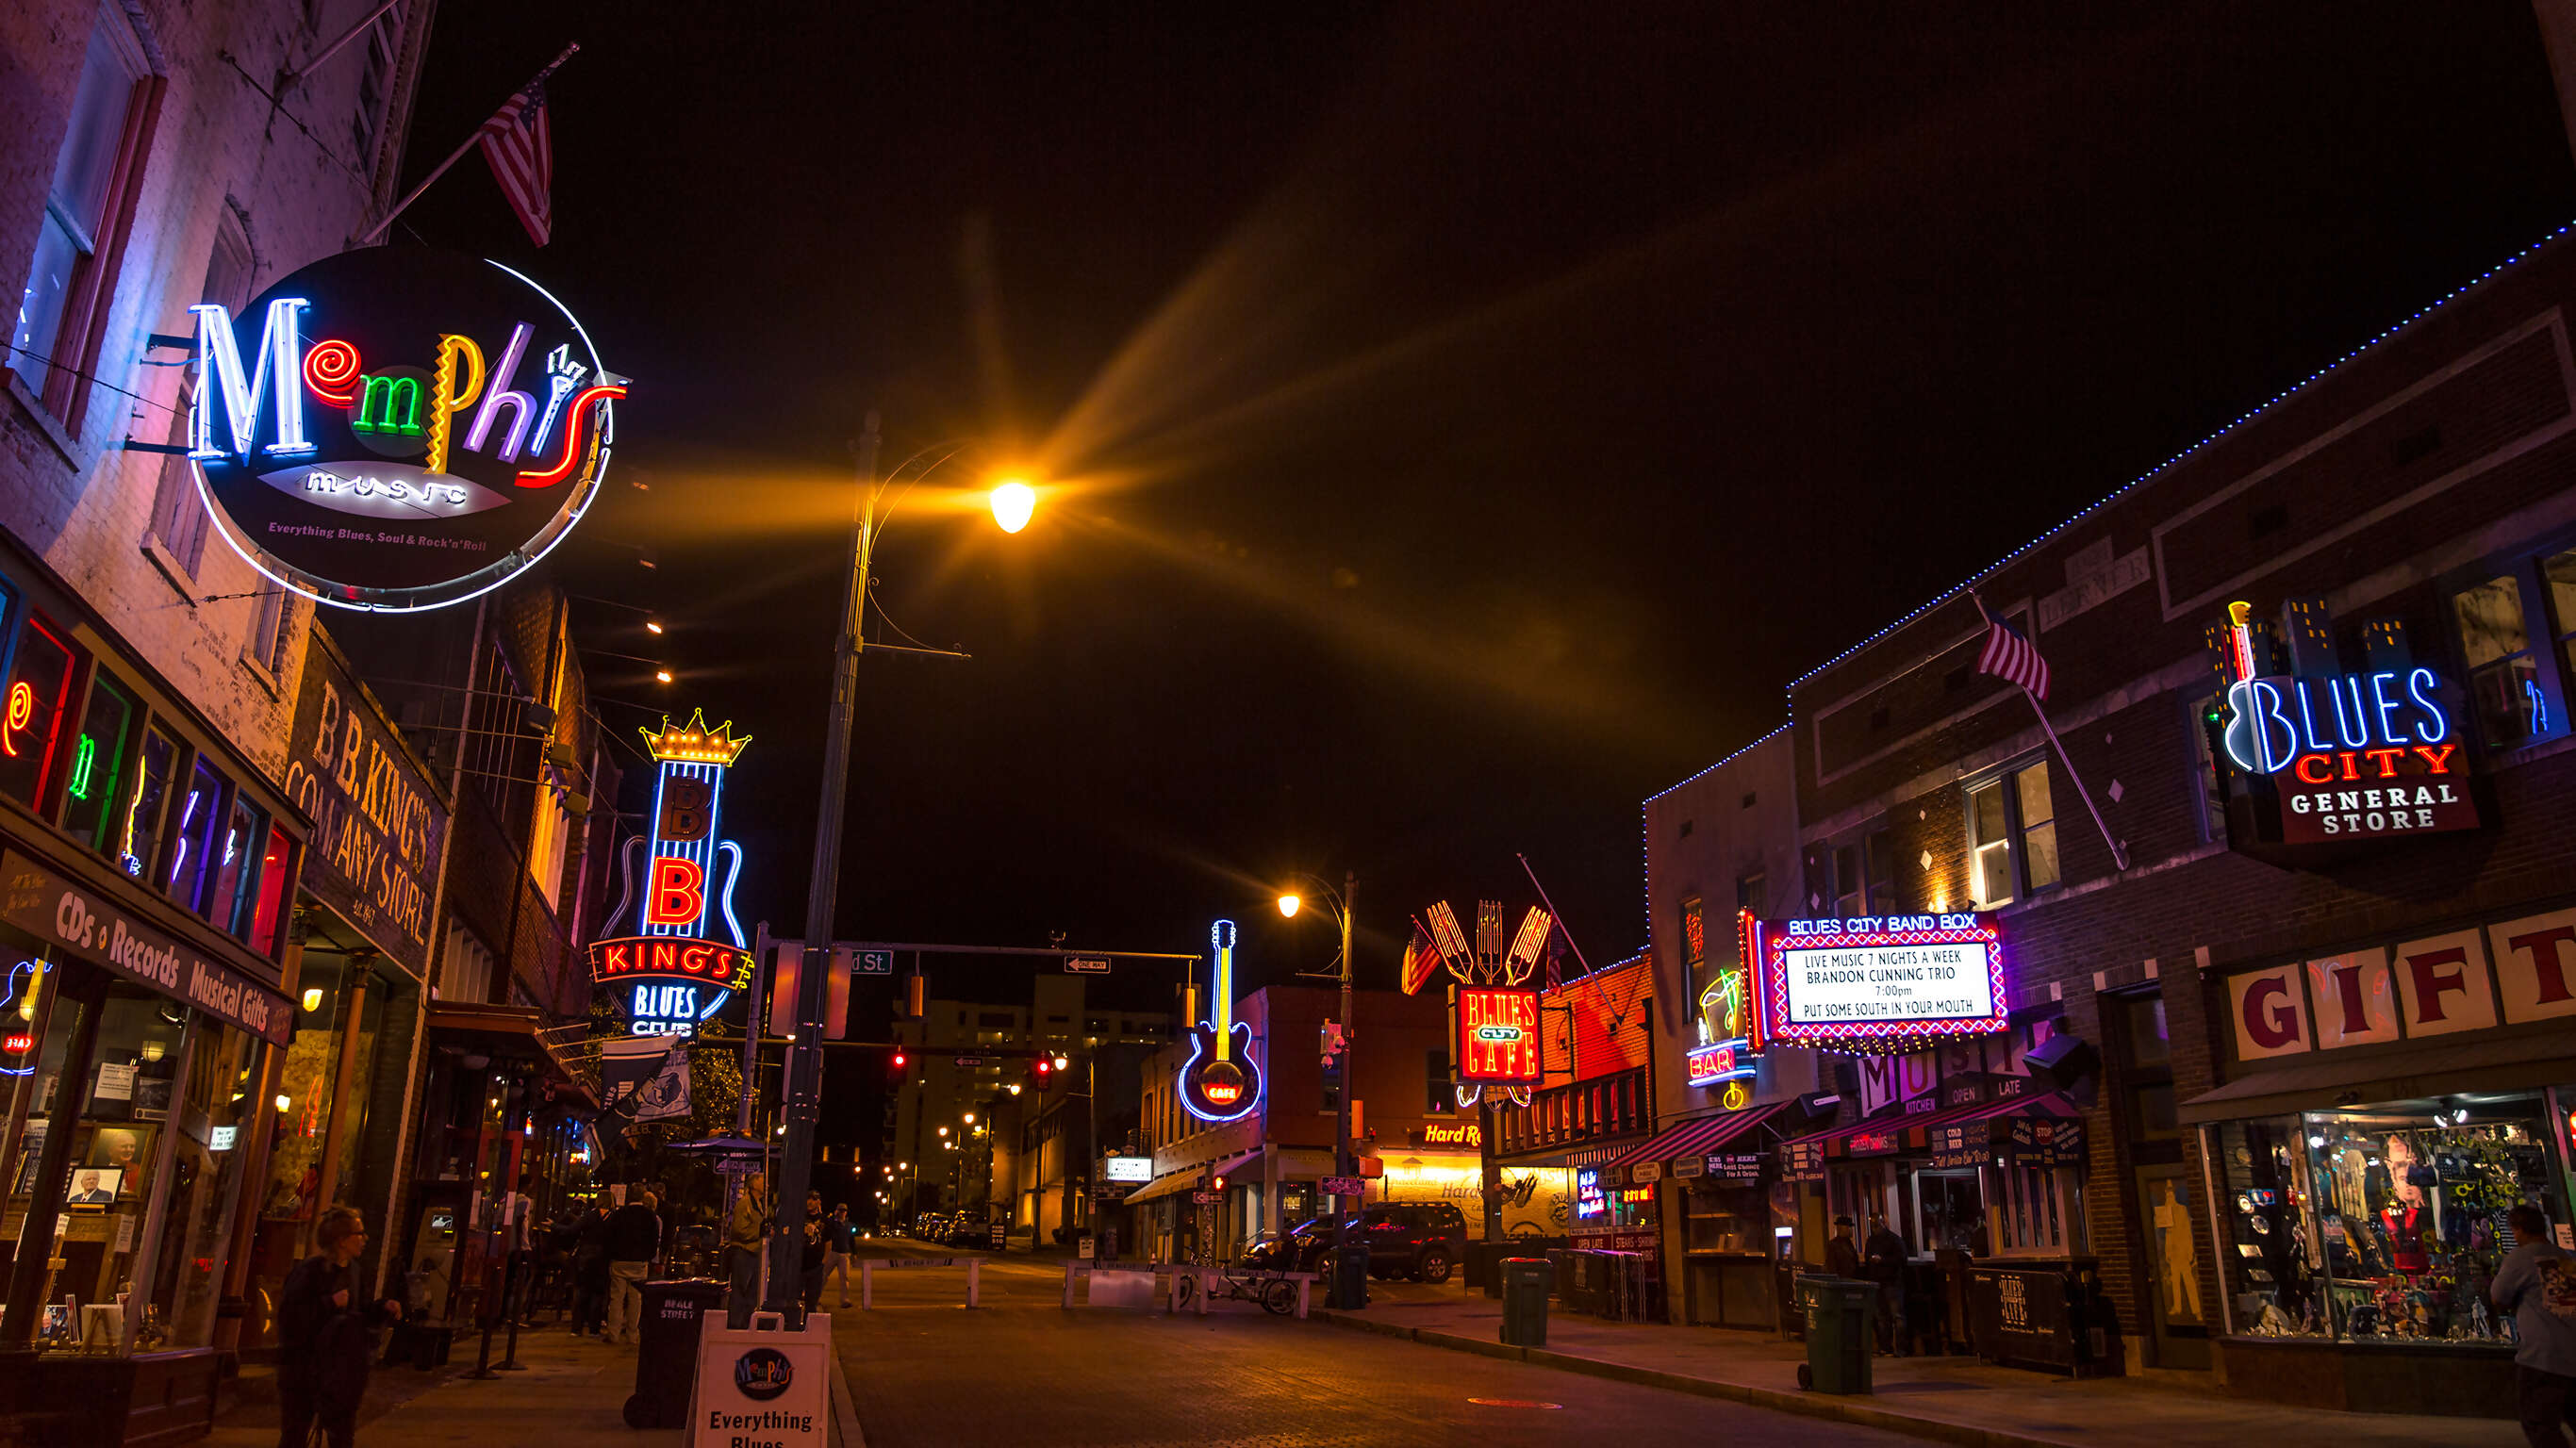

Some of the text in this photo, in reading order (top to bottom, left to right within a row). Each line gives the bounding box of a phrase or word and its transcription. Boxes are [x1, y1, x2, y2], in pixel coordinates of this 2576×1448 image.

[188, 296, 628, 489] Memphis
[305, 471, 468, 505] music
[269, 521, 487, 551] Everything Blues, Soul & Rock'n'Roll
[2251, 667, 2446, 773] BLUES
[2295, 744, 2456, 784] CITY
[657, 774, 712, 843] B
[2290, 783, 2459, 814] GENERAL
[2321, 809, 2436, 834] STORE
[377, 851, 425, 946] STORE
[648, 855, 703, 927] B
[1788, 913, 1977, 936] BLUES CITY BAND BOX
[56, 891, 95, 949] CDs
[109, 918, 180, 989] Records
[864, 953, 885, 972] St.
[1078, 960, 1106, 969] ONE WAY
[1805, 949, 1962, 968] LIVE MUSIC 7 NIGHTS A WEEK
[1807, 966, 1956, 984] BRANDON CUNNING TRIO
[189, 960, 243, 1019] Musical
[241, 989, 269, 1032] Gifts
[634, 984, 698, 1019] BLUES
[1875, 985, 1913, 998] 7:00pm
[1466, 994, 1535, 1027] BLUES
[1804, 999, 1973, 1018] PUT SOME SOUTH IN YOUR MOUTH
[1480, 1028, 1518, 1039] CITY
[1468, 1028, 1536, 1076] CAFE
[1689, 1049, 1734, 1078] BAR
[1209, 1087, 1236, 1099] CAFE
[1905, 1078, 2021, 1115] KITCHEN OPEN LATE
[1425, 1124, 1466, 1144] Hard
[1947, 1127, 1962, 1138] COLD
[1948, 1138, 1963, 1150] BEER
[2036, 1127, 2052, 1138] STOP
[1577, 1238, 1604, 1248] OPEN LATE
[1615, 1236, 1635, 1248] STEAKS
[660, 1309, 695, 1320] STREET
[663, 1299, 694, 1309] BEALE
[709, 1410, 813, 1433] Everything
[731, 1437, 784, 1448] Blues
